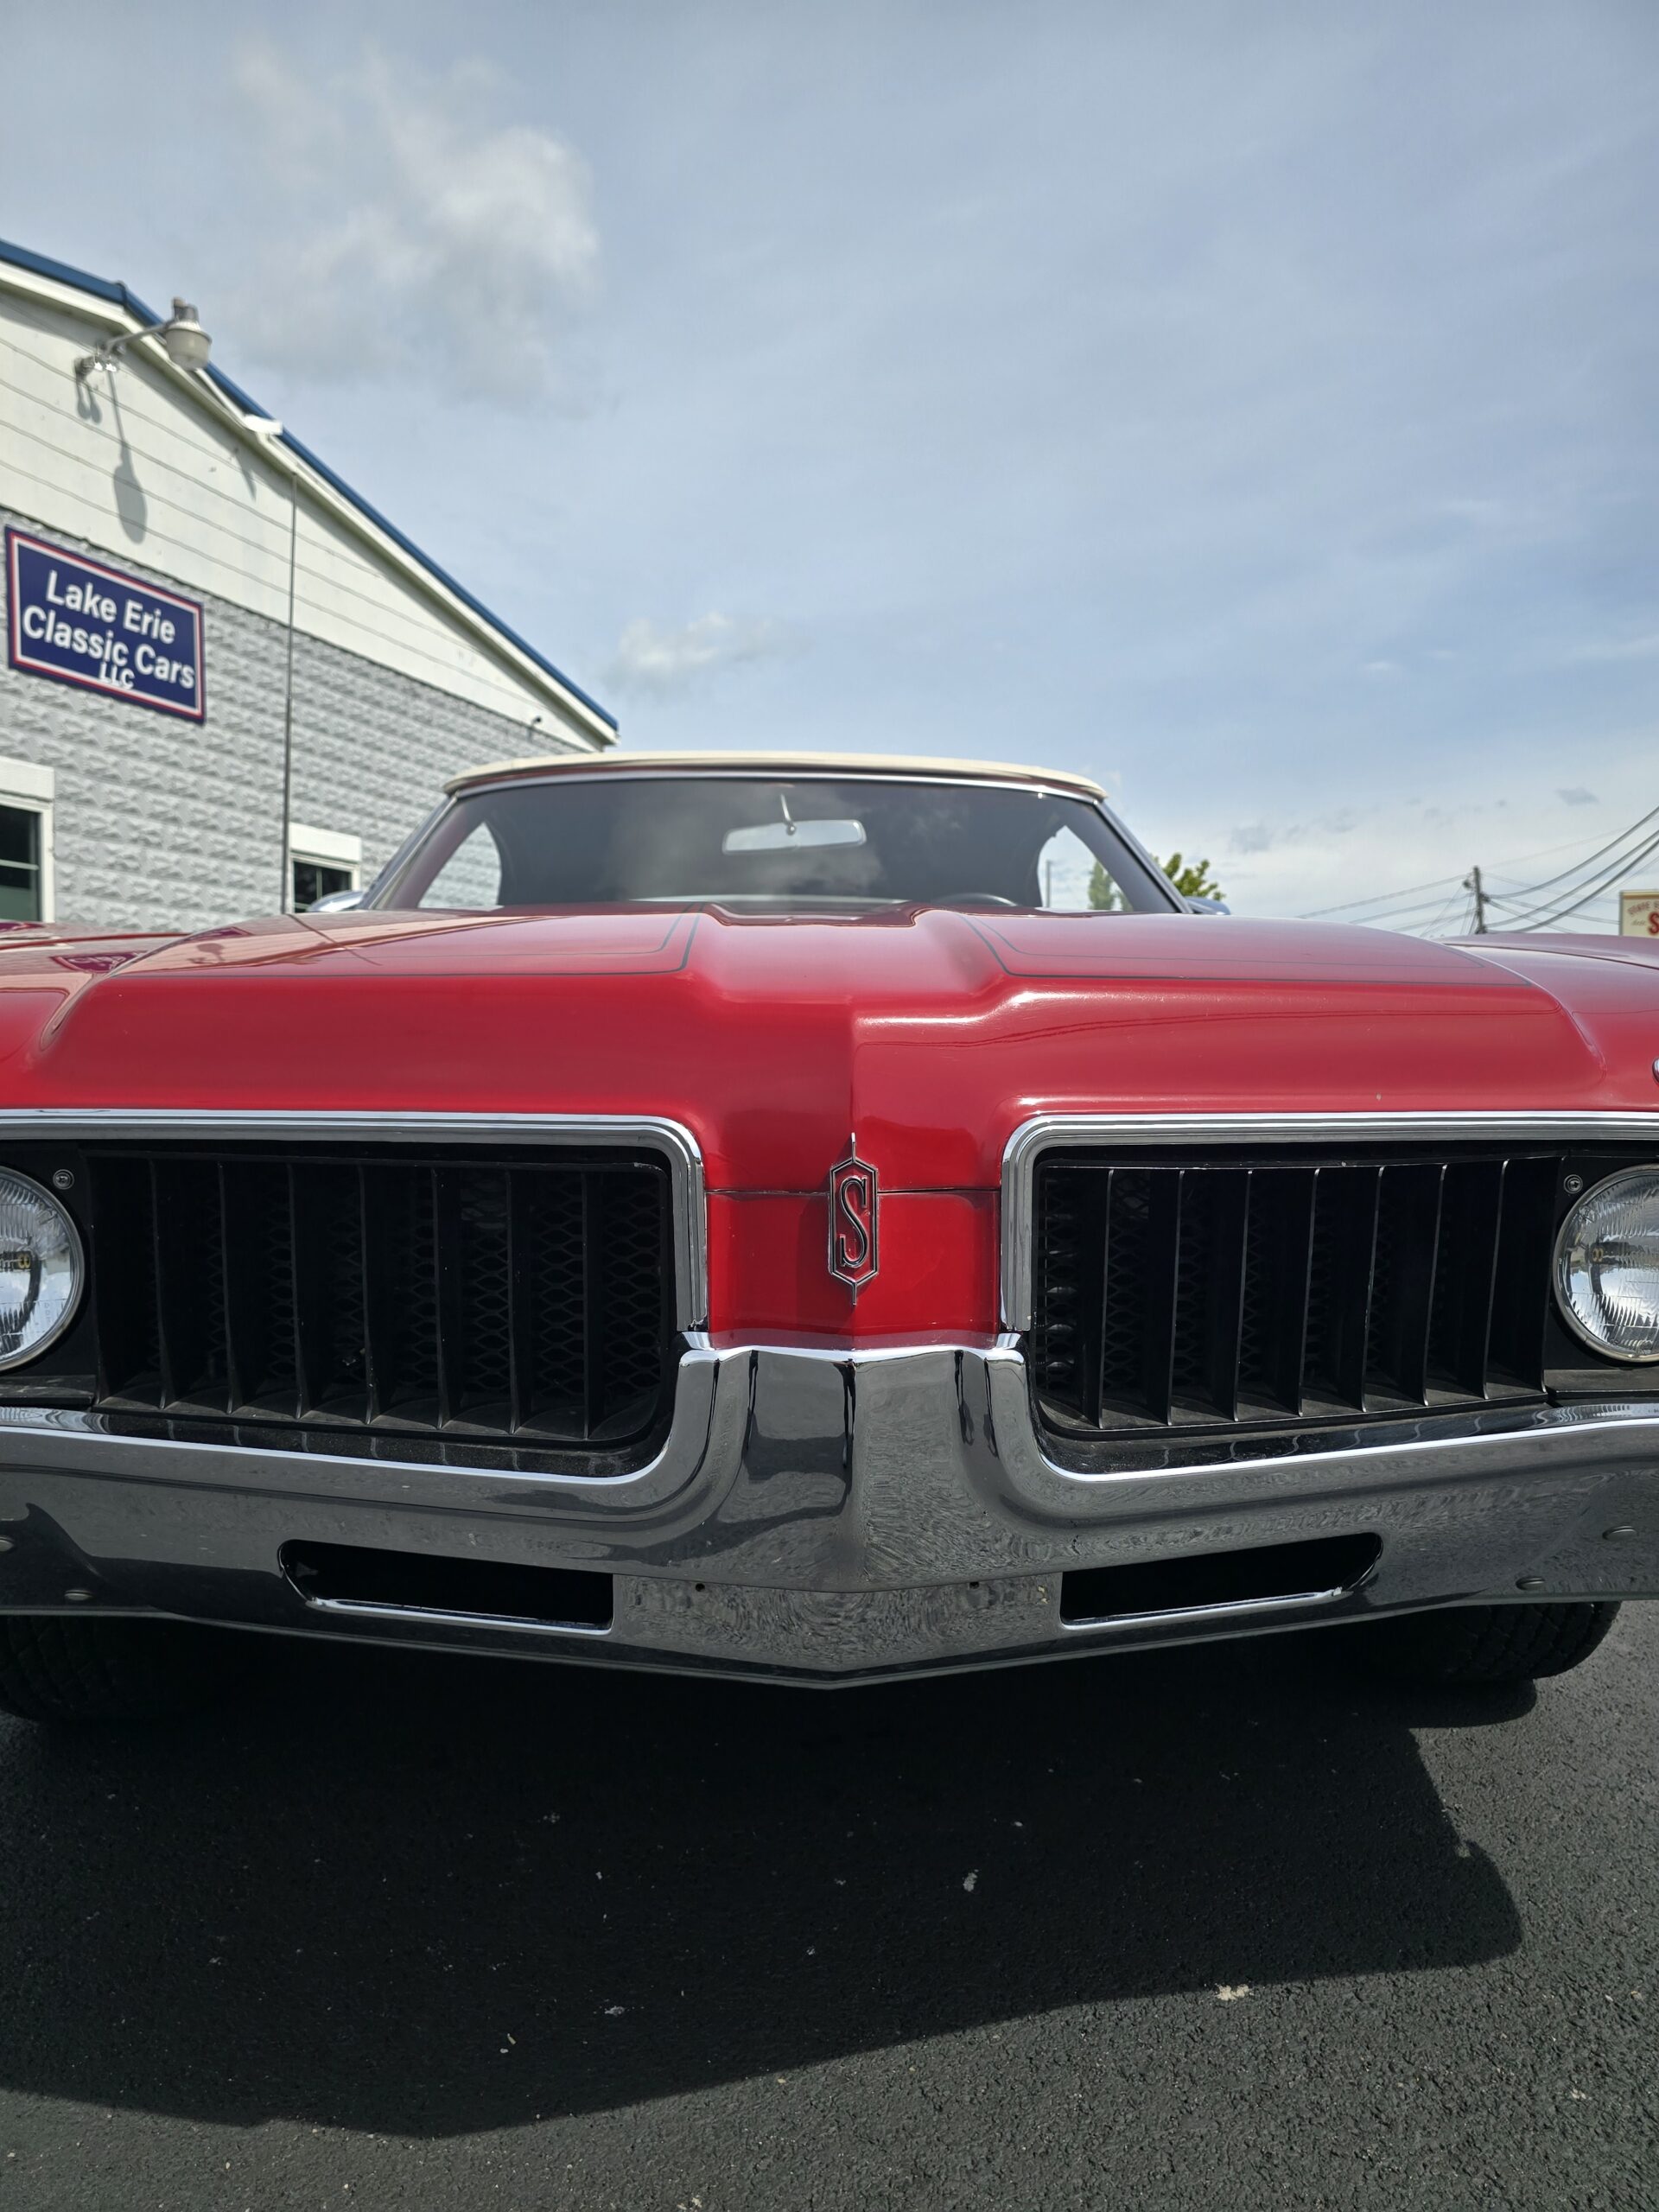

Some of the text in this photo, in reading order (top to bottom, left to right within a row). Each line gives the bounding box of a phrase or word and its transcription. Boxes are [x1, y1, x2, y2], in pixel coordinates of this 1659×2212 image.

[46, 570, 175, 644] Lake Erie
[22, 606, 194, 689] Classic Cars
[99, 662, 135, 690] LLC
